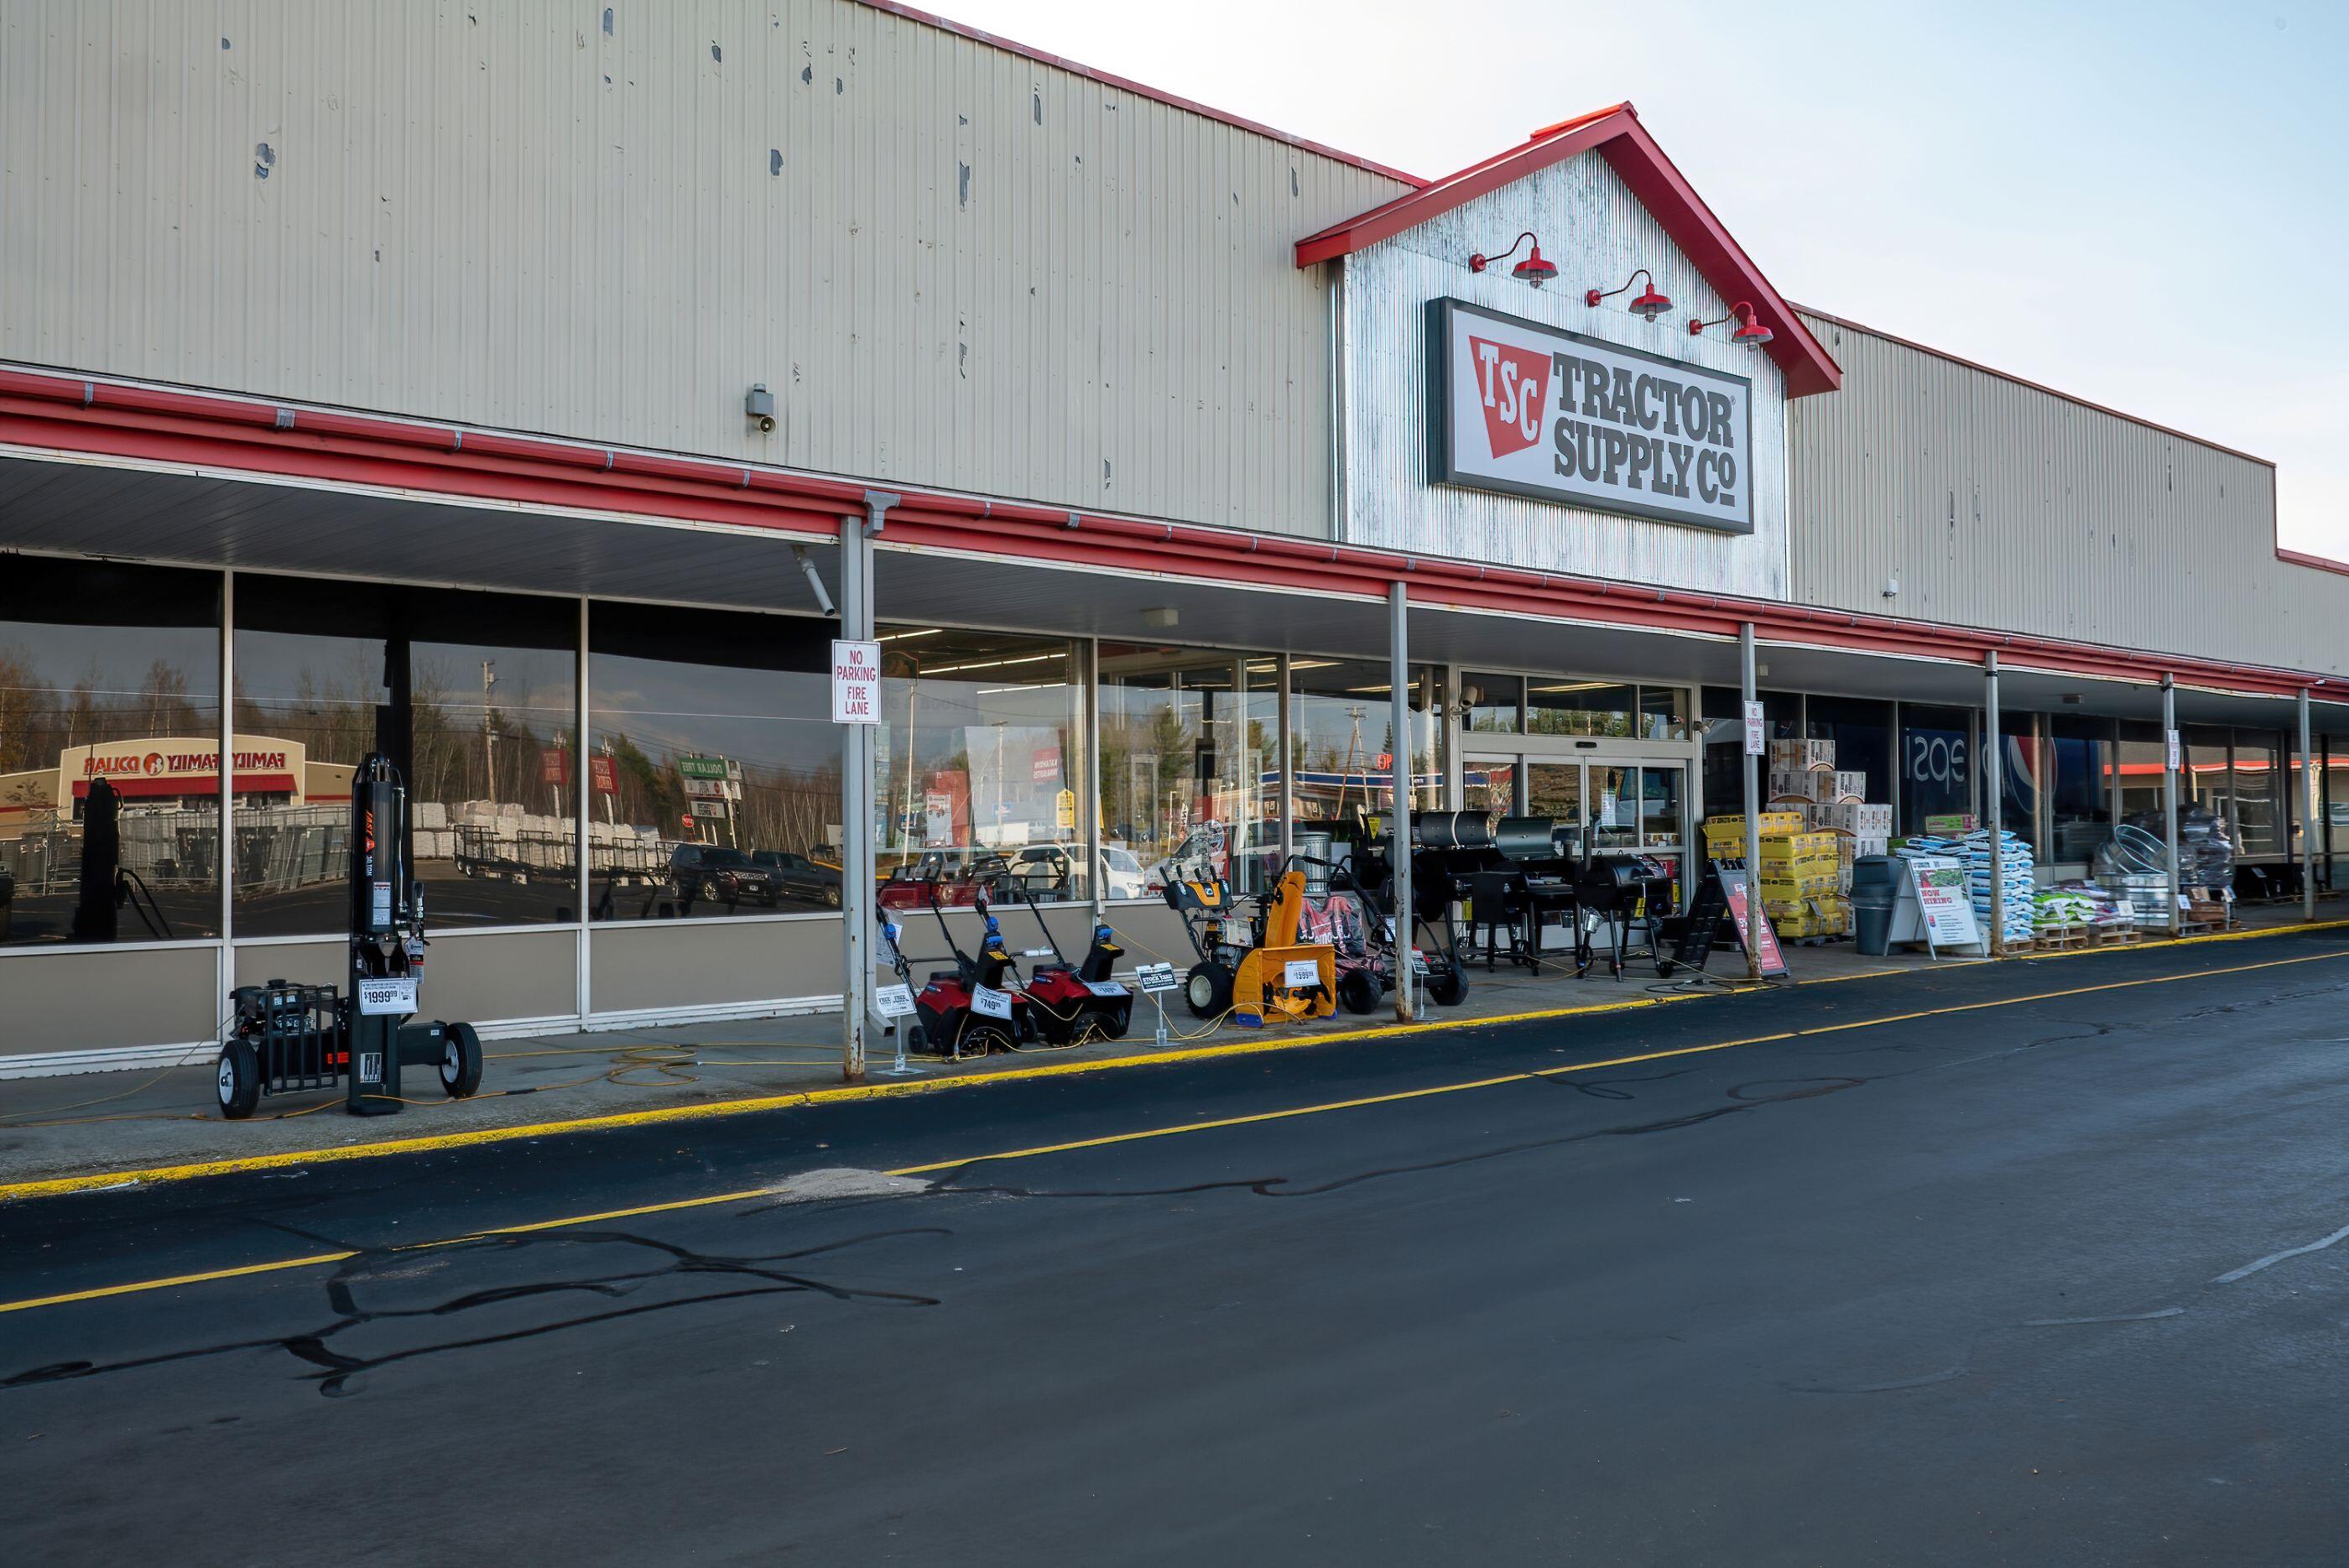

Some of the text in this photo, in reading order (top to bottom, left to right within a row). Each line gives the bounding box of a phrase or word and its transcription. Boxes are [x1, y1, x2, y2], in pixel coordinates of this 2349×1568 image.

[1479, 342, 1538, 440] TSC
[1553, 351, 1734, 447] TRACTOR
[1554, 416, 1694, 499] SUPPLY
[849, 650, 862, 664] NO
[836, 665, 876, 681] PARKING
[847, 686, 867, 700] FIRE
[846, 701, 869, 715] LANE
[1378, 753, 1393, 770] OP
